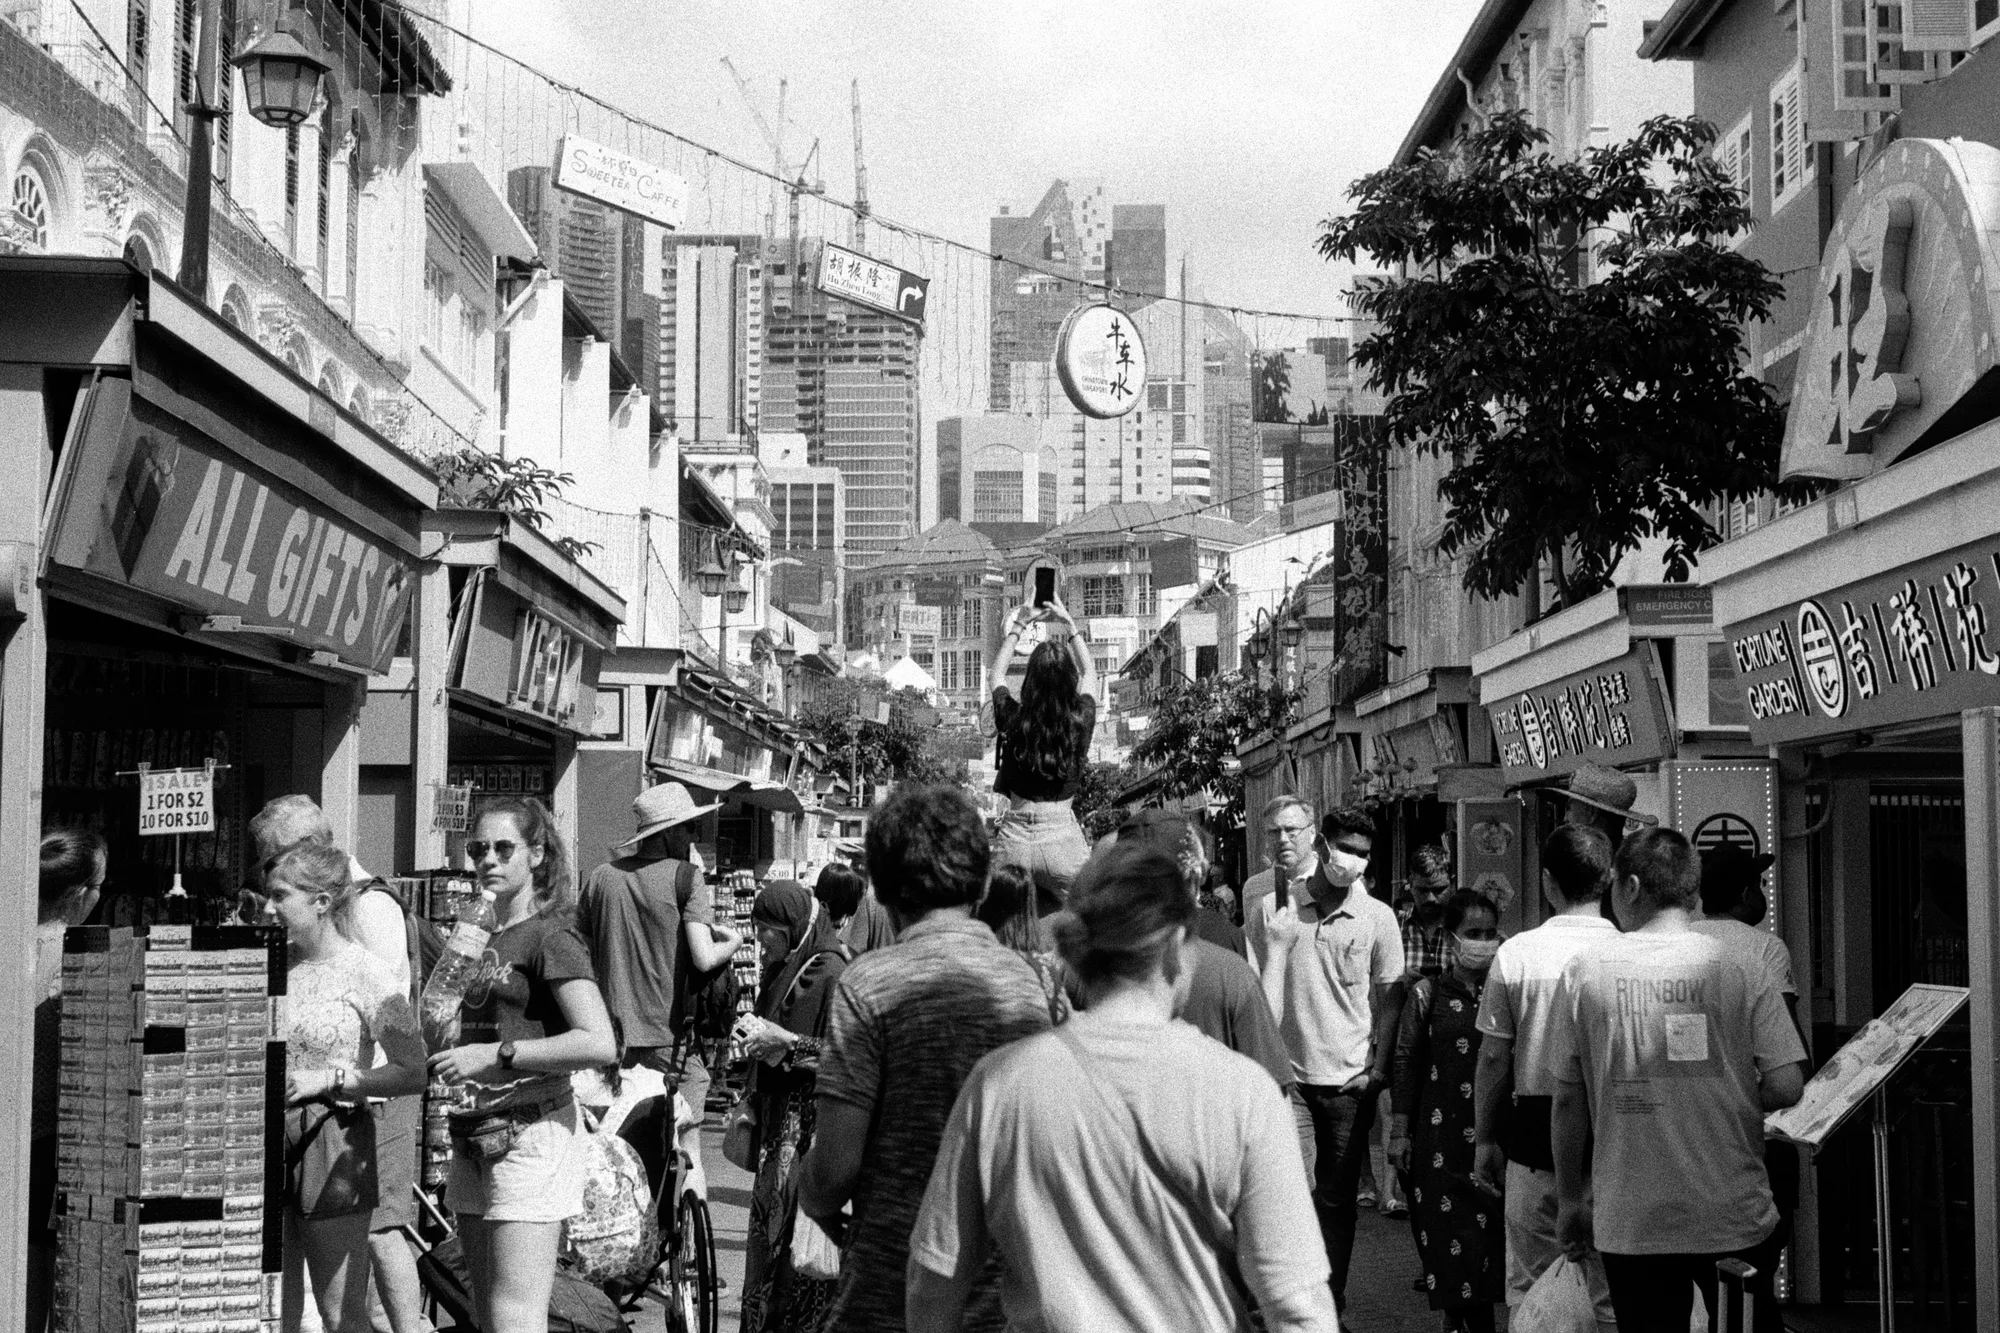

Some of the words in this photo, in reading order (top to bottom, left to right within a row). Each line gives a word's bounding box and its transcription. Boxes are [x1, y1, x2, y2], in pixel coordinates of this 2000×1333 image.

[637, 175, 679, 208] CAFFE
[829, 253, 882, 288] 胡振隆
[1106, 316, 1135, 402] 牛车水
[165, 459, 257, 605] ALL
[267, 507, 380, 646] GIFTS
[1636, 601, 1700, 611] EMERGENCY
[1658, 591, 1680, 600] FIRE
[1733, 627, 1788, 674] FORTUNE
[1748, 676, 1802, 720] GARDEN
[147, 794, 154, 810] 1
[157, 792, 184, 809] FOR
[141, 814, 155, 829] 10
[158, 813, 183, 828] FOR
